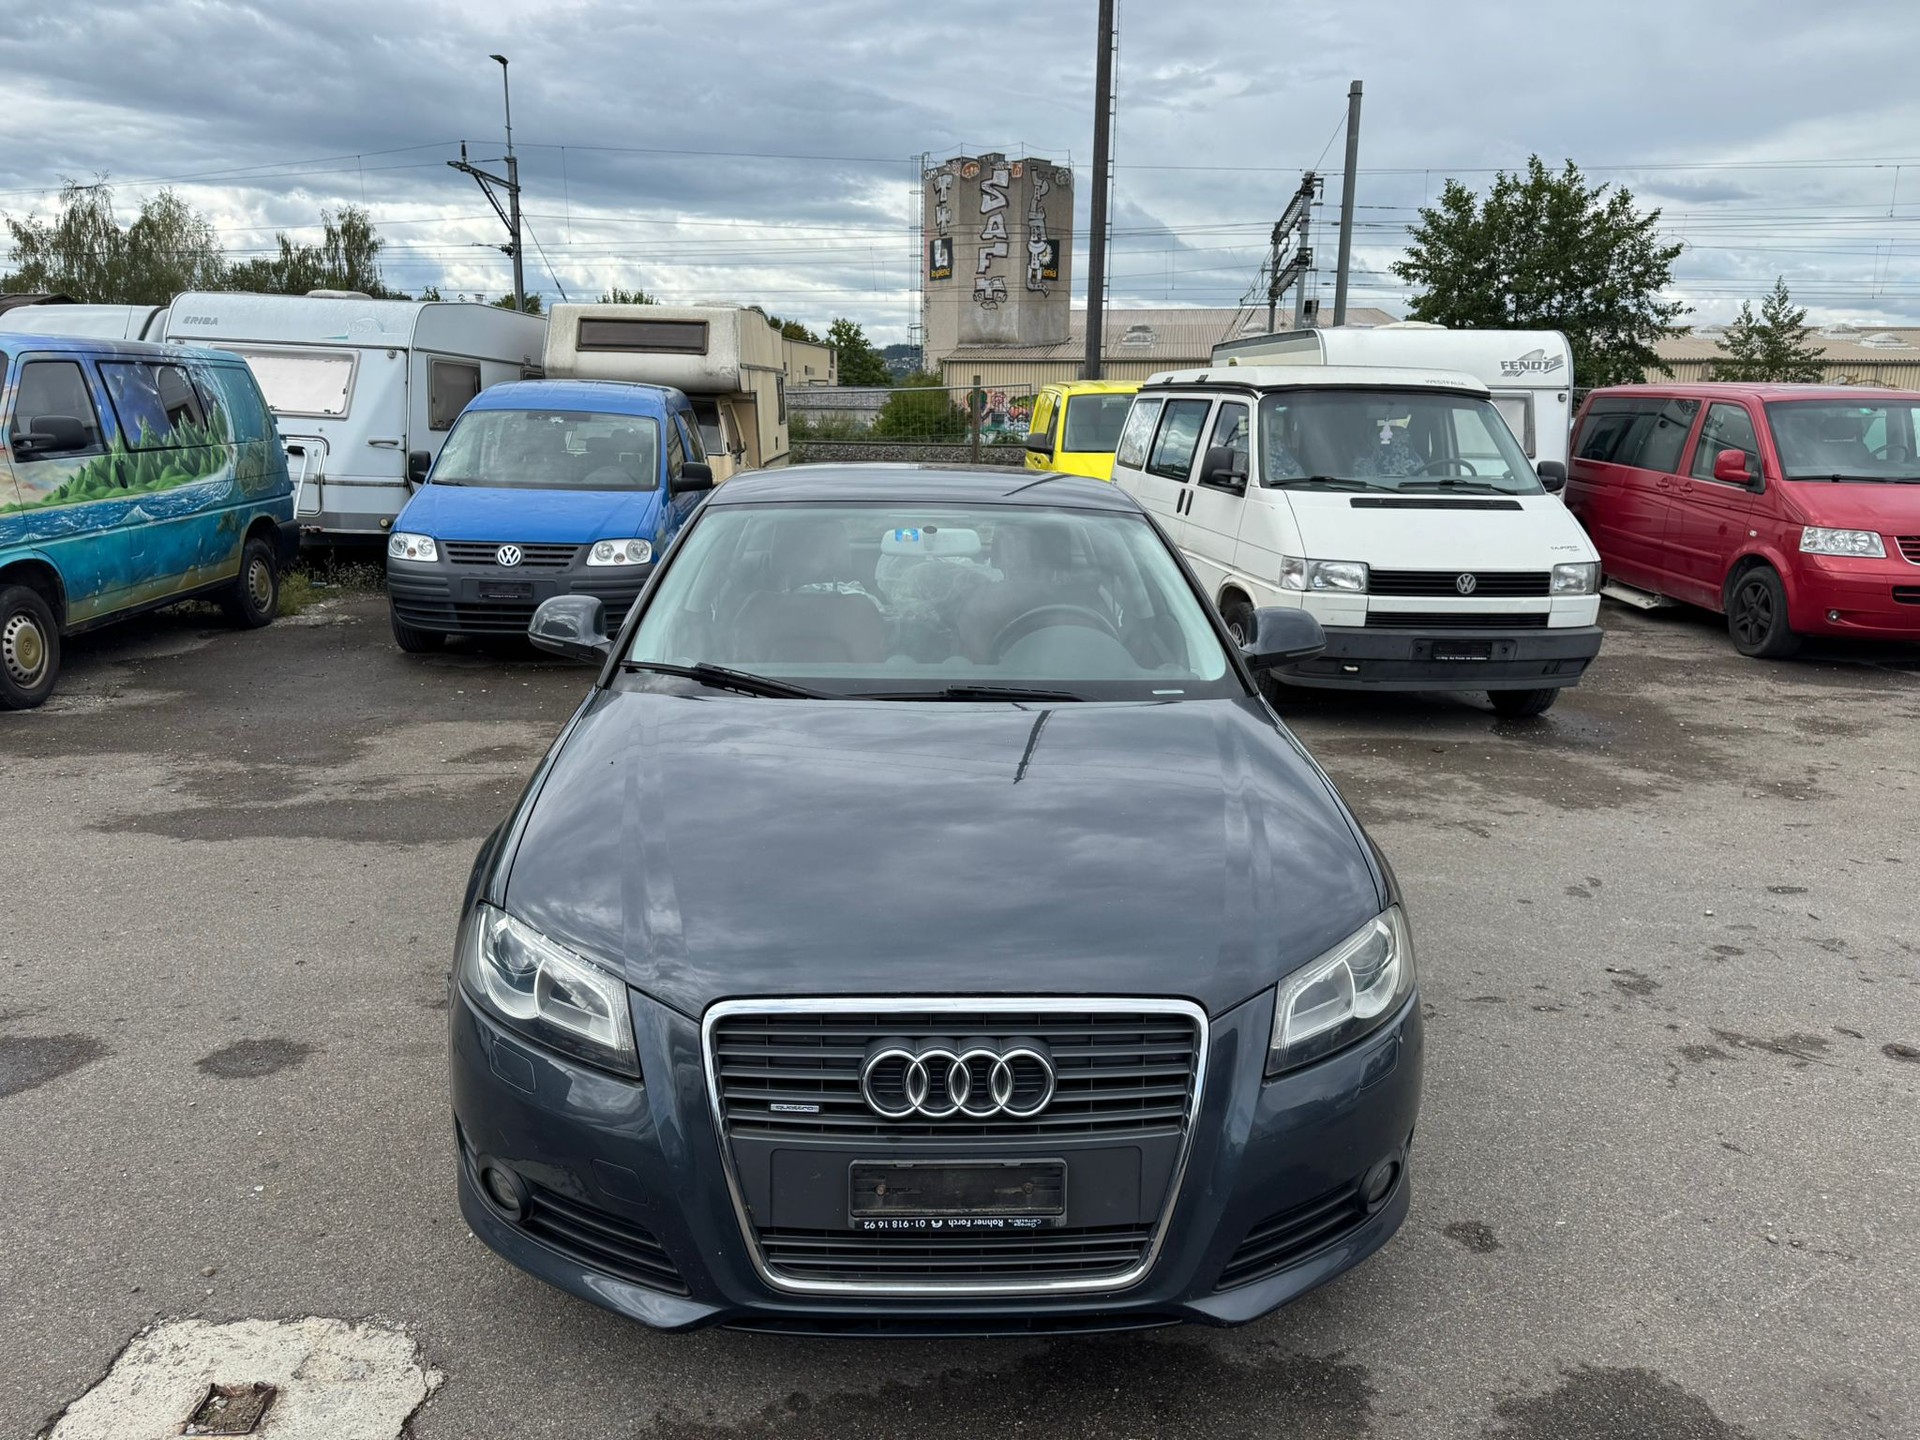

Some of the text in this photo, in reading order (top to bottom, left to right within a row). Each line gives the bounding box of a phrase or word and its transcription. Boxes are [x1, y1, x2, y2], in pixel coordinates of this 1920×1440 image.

[182, 315, 219, 326] ERIBA
[1500, 360, 1553, 371] FENDT
[498, 545, 521, 566] VW
[1457, 573, 1477, 594] VW
[864, 1221, 876, 1230] 92
[878, 1220, 889, 1229] 16
[948, 1219, 971, 1228] Forch
[973, 1219, 1004, 1228] Rohner
